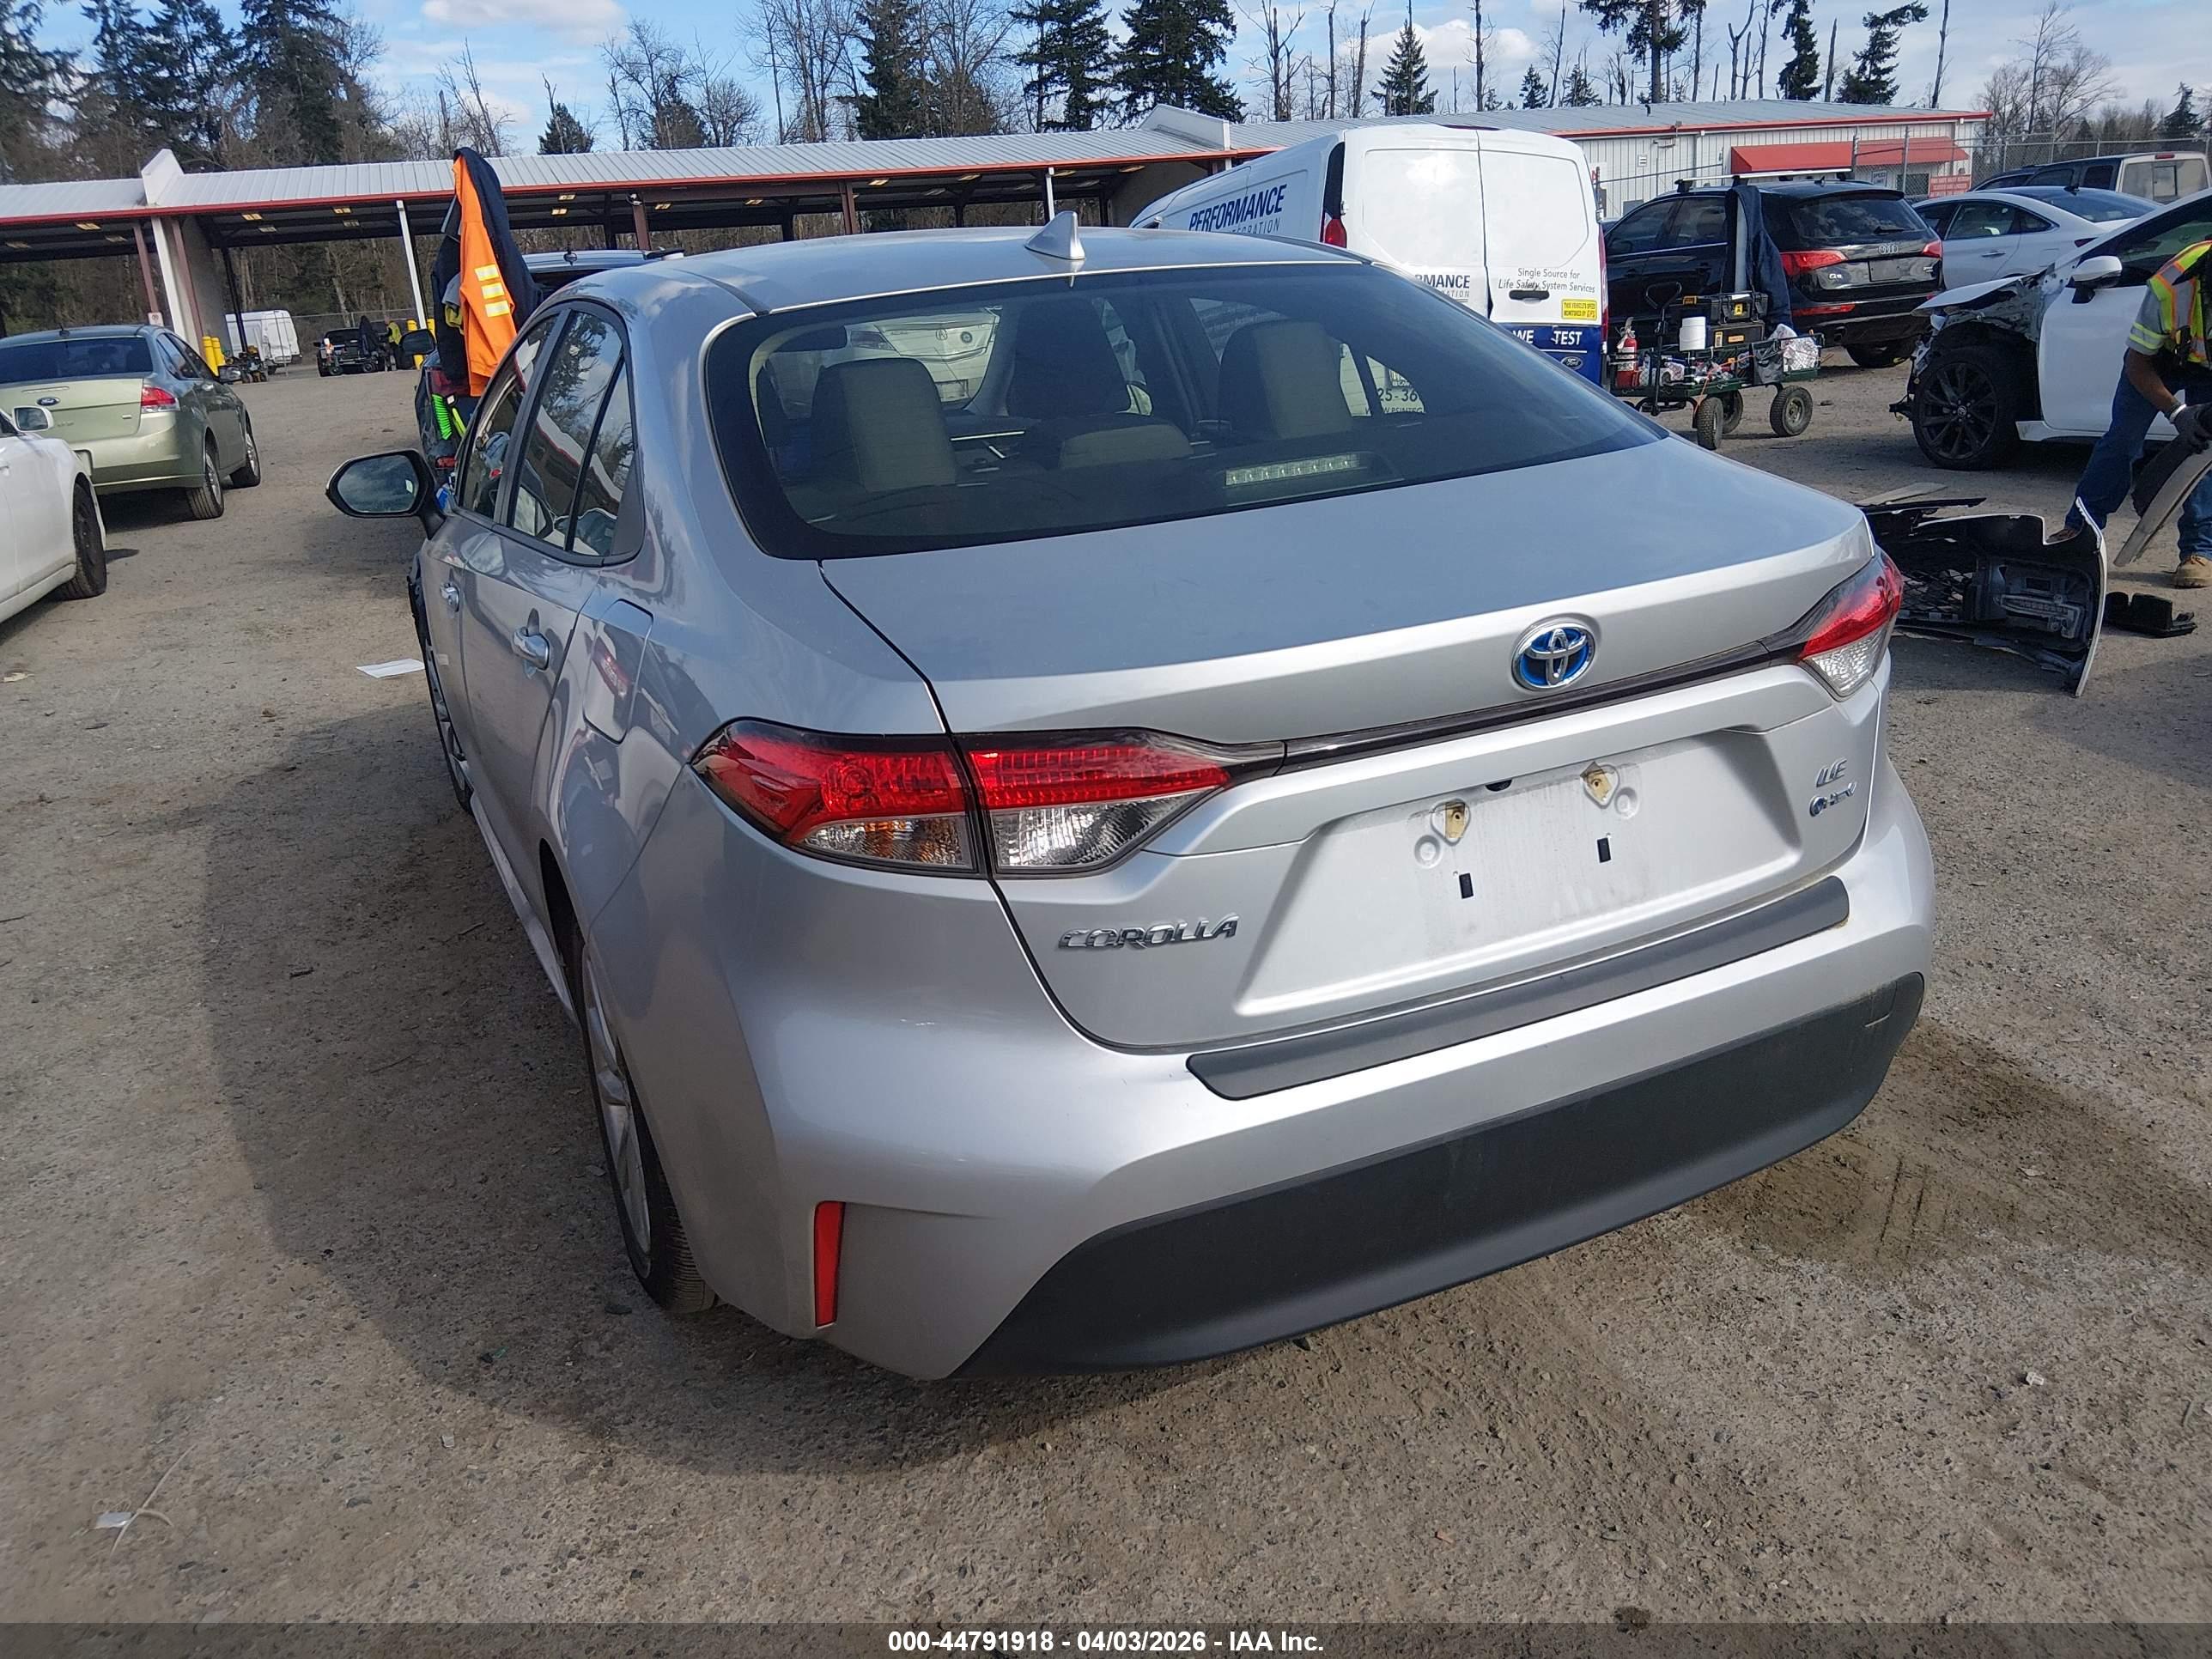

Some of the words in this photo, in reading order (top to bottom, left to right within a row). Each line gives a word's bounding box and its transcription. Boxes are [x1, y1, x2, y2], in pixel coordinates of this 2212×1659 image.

[1188, 184, 1287, 232] PERFORMANCE
[1517, 267, 1540, 279] Single
[1543, 269, 1568, 279] Source
[1570, 270, 1580, 279] for
[1498, 278, 1514, 289] Life
[1516, 279, 1539, 291] Safety
[1542, 280, 1568, 292] System
[1570, 282, 1595, 293] Services
[1512, 330, 1534, 344] WE
[1553, 331, 1583, 345] TEST
[1815, 758, 1848, 788] LE
[1058, 912, 1240, 950] COROLLA
